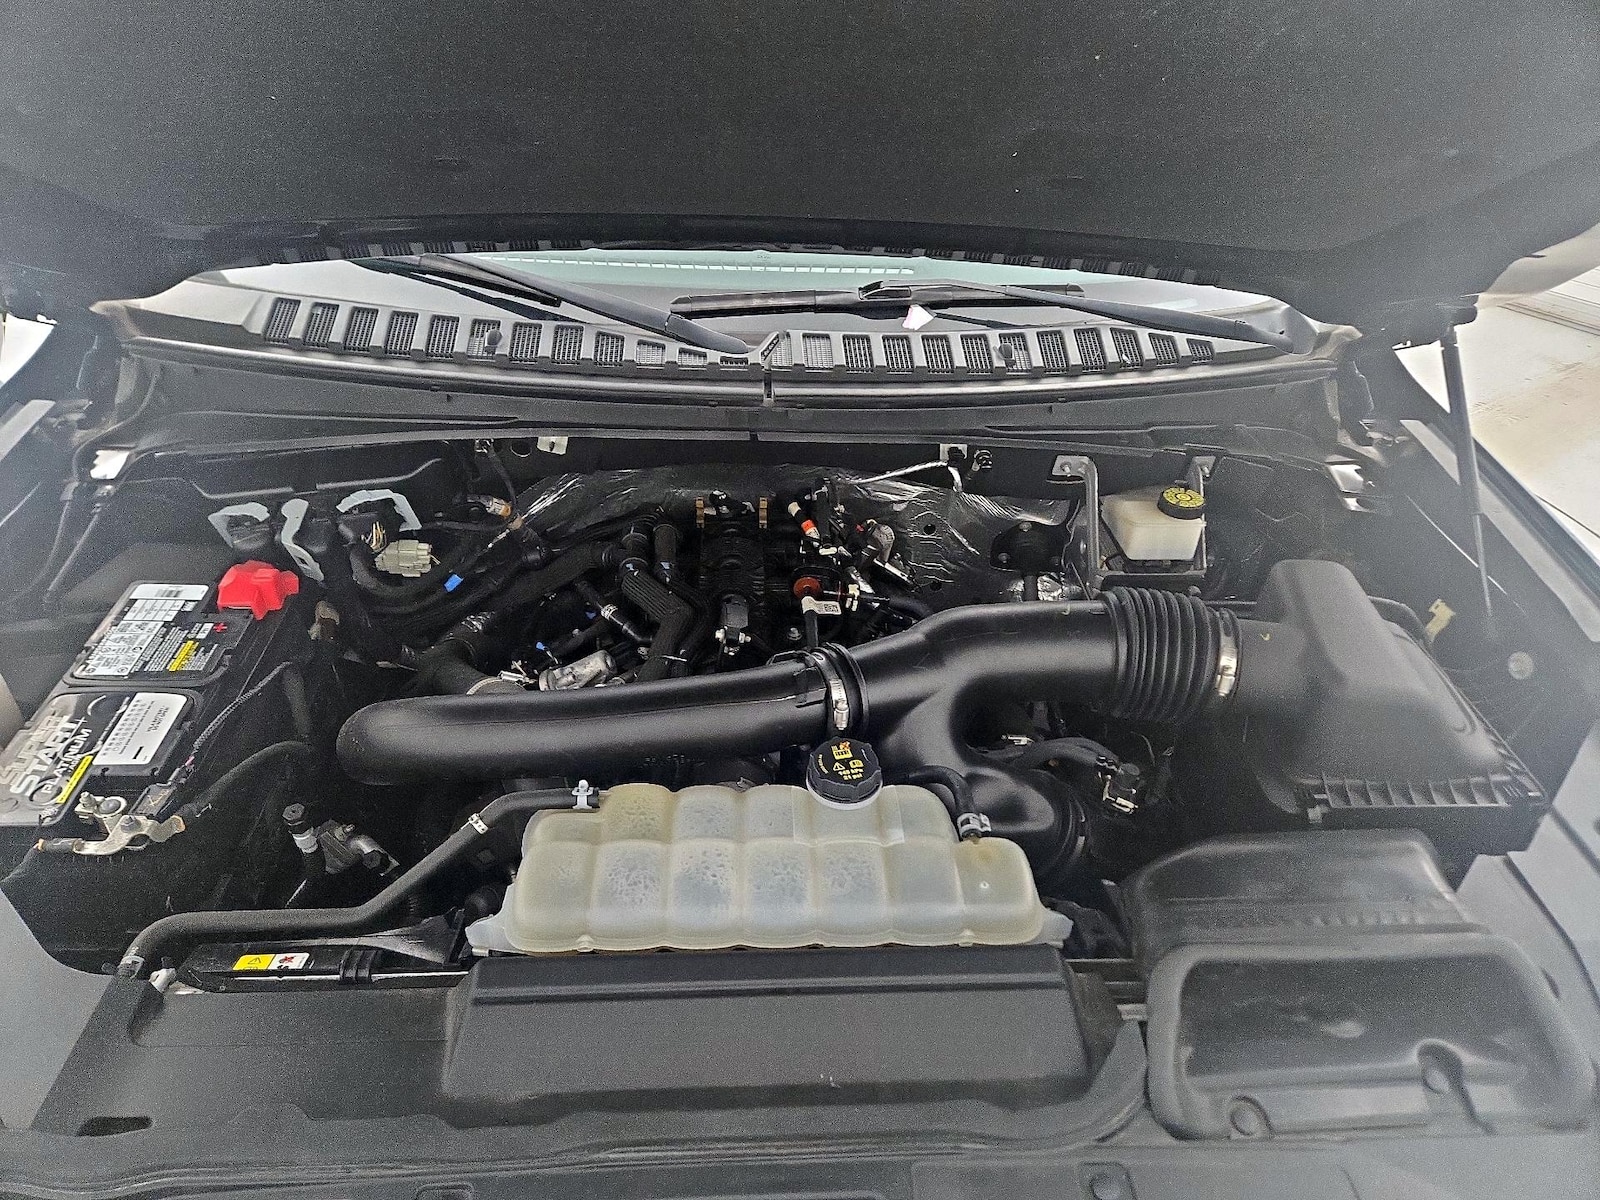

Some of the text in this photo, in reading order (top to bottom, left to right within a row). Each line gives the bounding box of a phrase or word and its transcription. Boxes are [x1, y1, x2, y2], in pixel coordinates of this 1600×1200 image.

[0, 715, 64, 786] SUPER
[10, 714, 77, 797] START
[41, 728, 92, 793] PLATINUM
